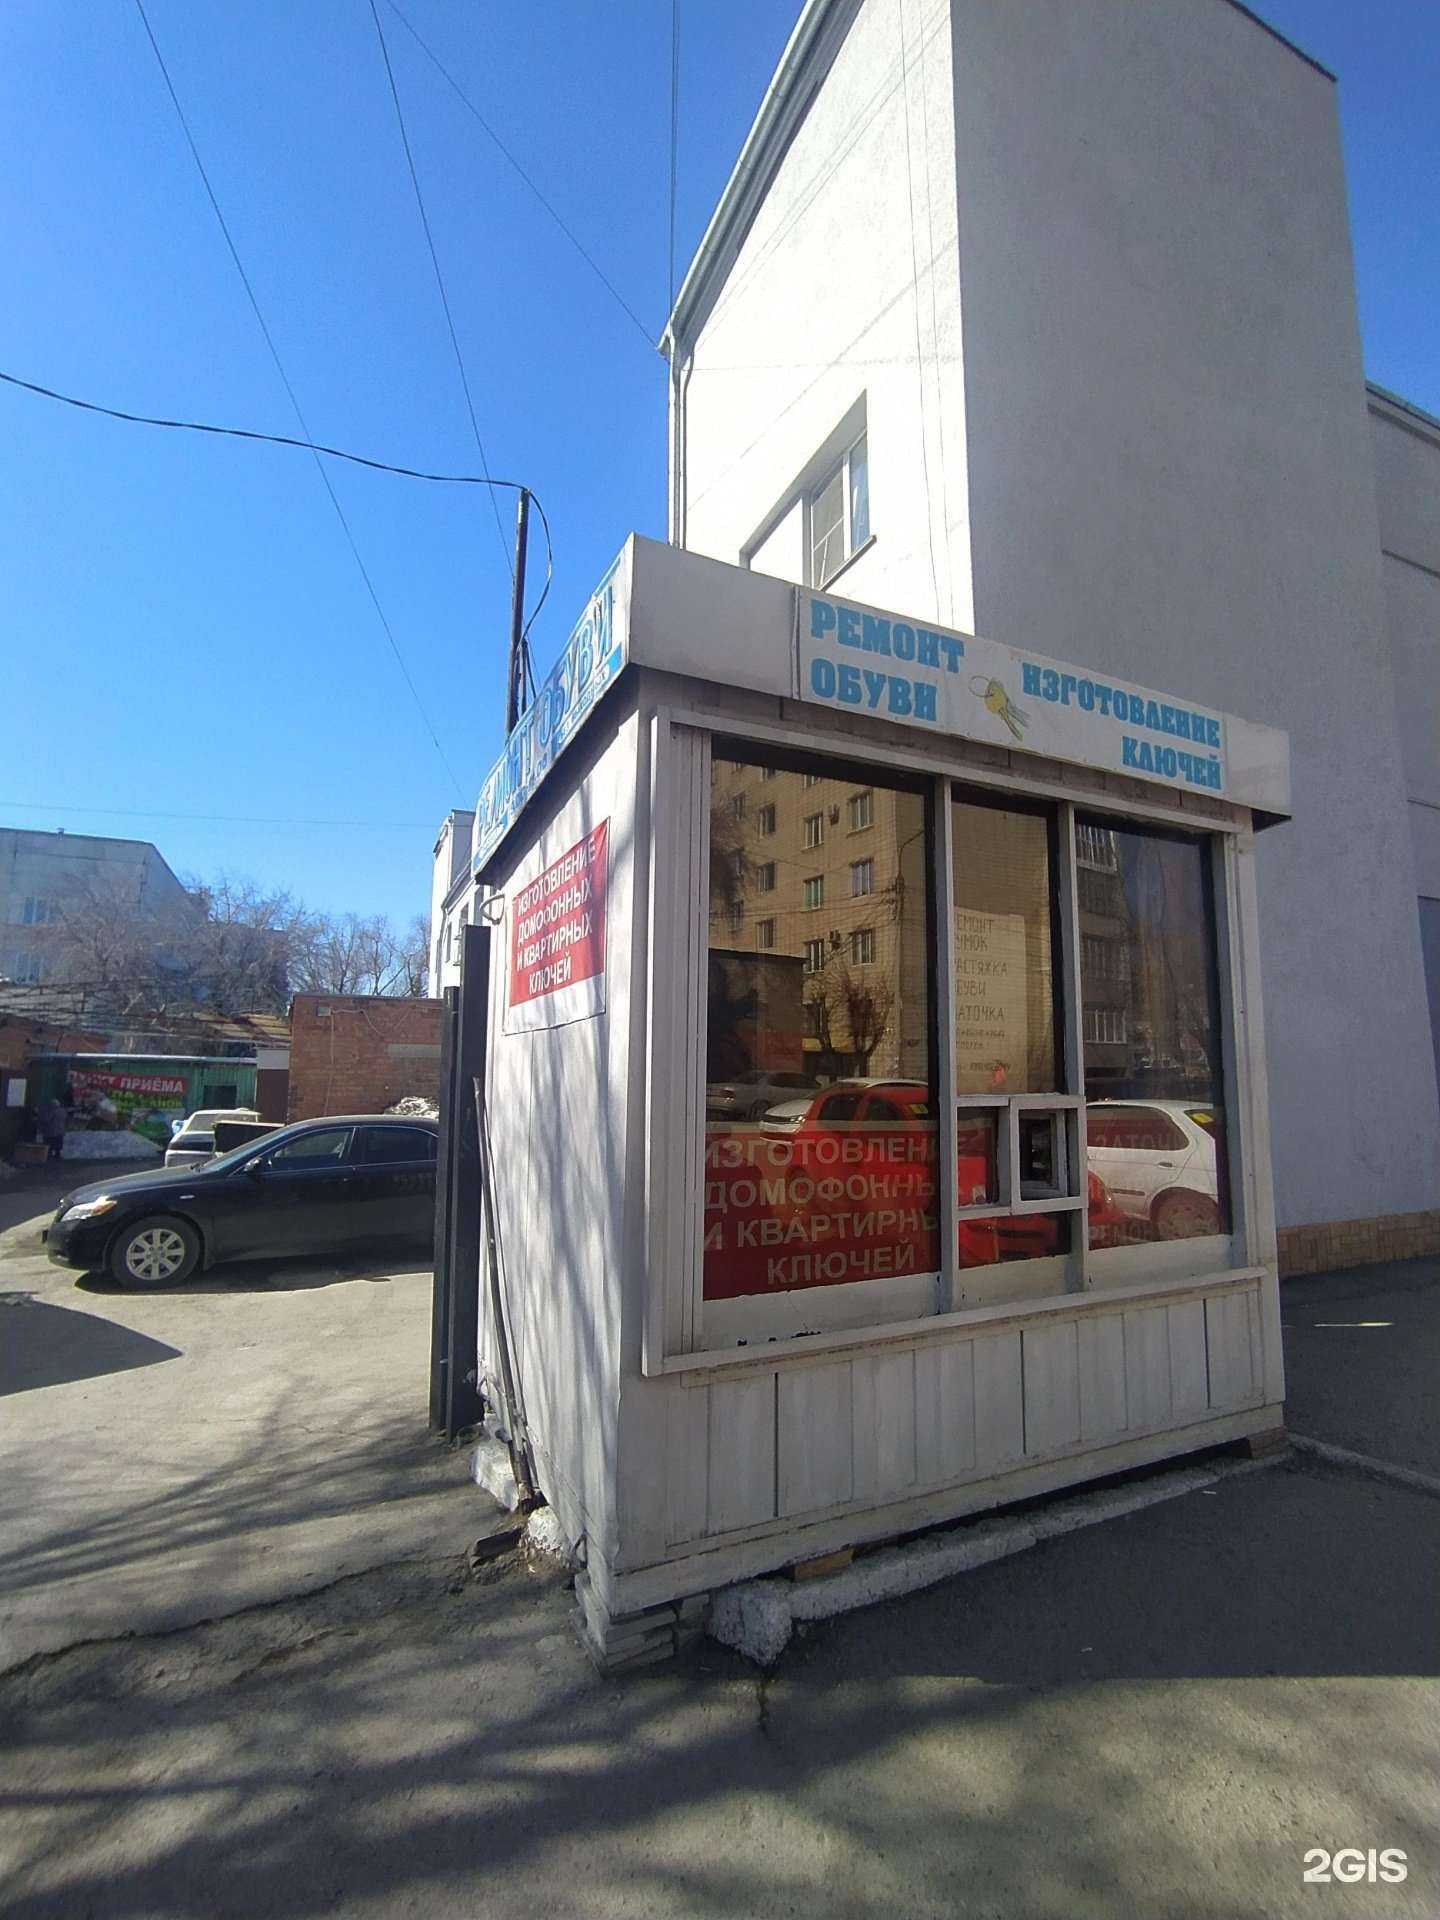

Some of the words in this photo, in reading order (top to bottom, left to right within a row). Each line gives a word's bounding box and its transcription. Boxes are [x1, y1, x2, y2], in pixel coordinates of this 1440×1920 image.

[539, 585, 614, 746] ОБУВИ
[810, 599, 964, 674] РЕМОНТ
[810, 658, 938, 722] ОБУВИ
[1022, 662, 1220, 749] ИЗГОТОВЛЕНИЕ
[1122, 736, 1222, 790] КЛЮЧЕЙ
[518, 838, 596, 917] ИЗГОТОВЛЕНИЕ
[517, 877, 593, 944] ДОМОФОННЫХ
[955, 913, 994, 934] ЕМОНТ
[516, 953, 524, 972] И
[523, 910, 593, 969] КВАРТИРНЫХ
[955, 959, 1008, 976] АСТЯЖКА
[529, 953, 573, 995] КЛЮЧЕЙ
[956, 1005, 1005, 1022] АТОЧКА
[120, 1075, 183, 1093] ПРИЁМА
[767, 1237, 915, 1284] КЛЮЧЕЙ
